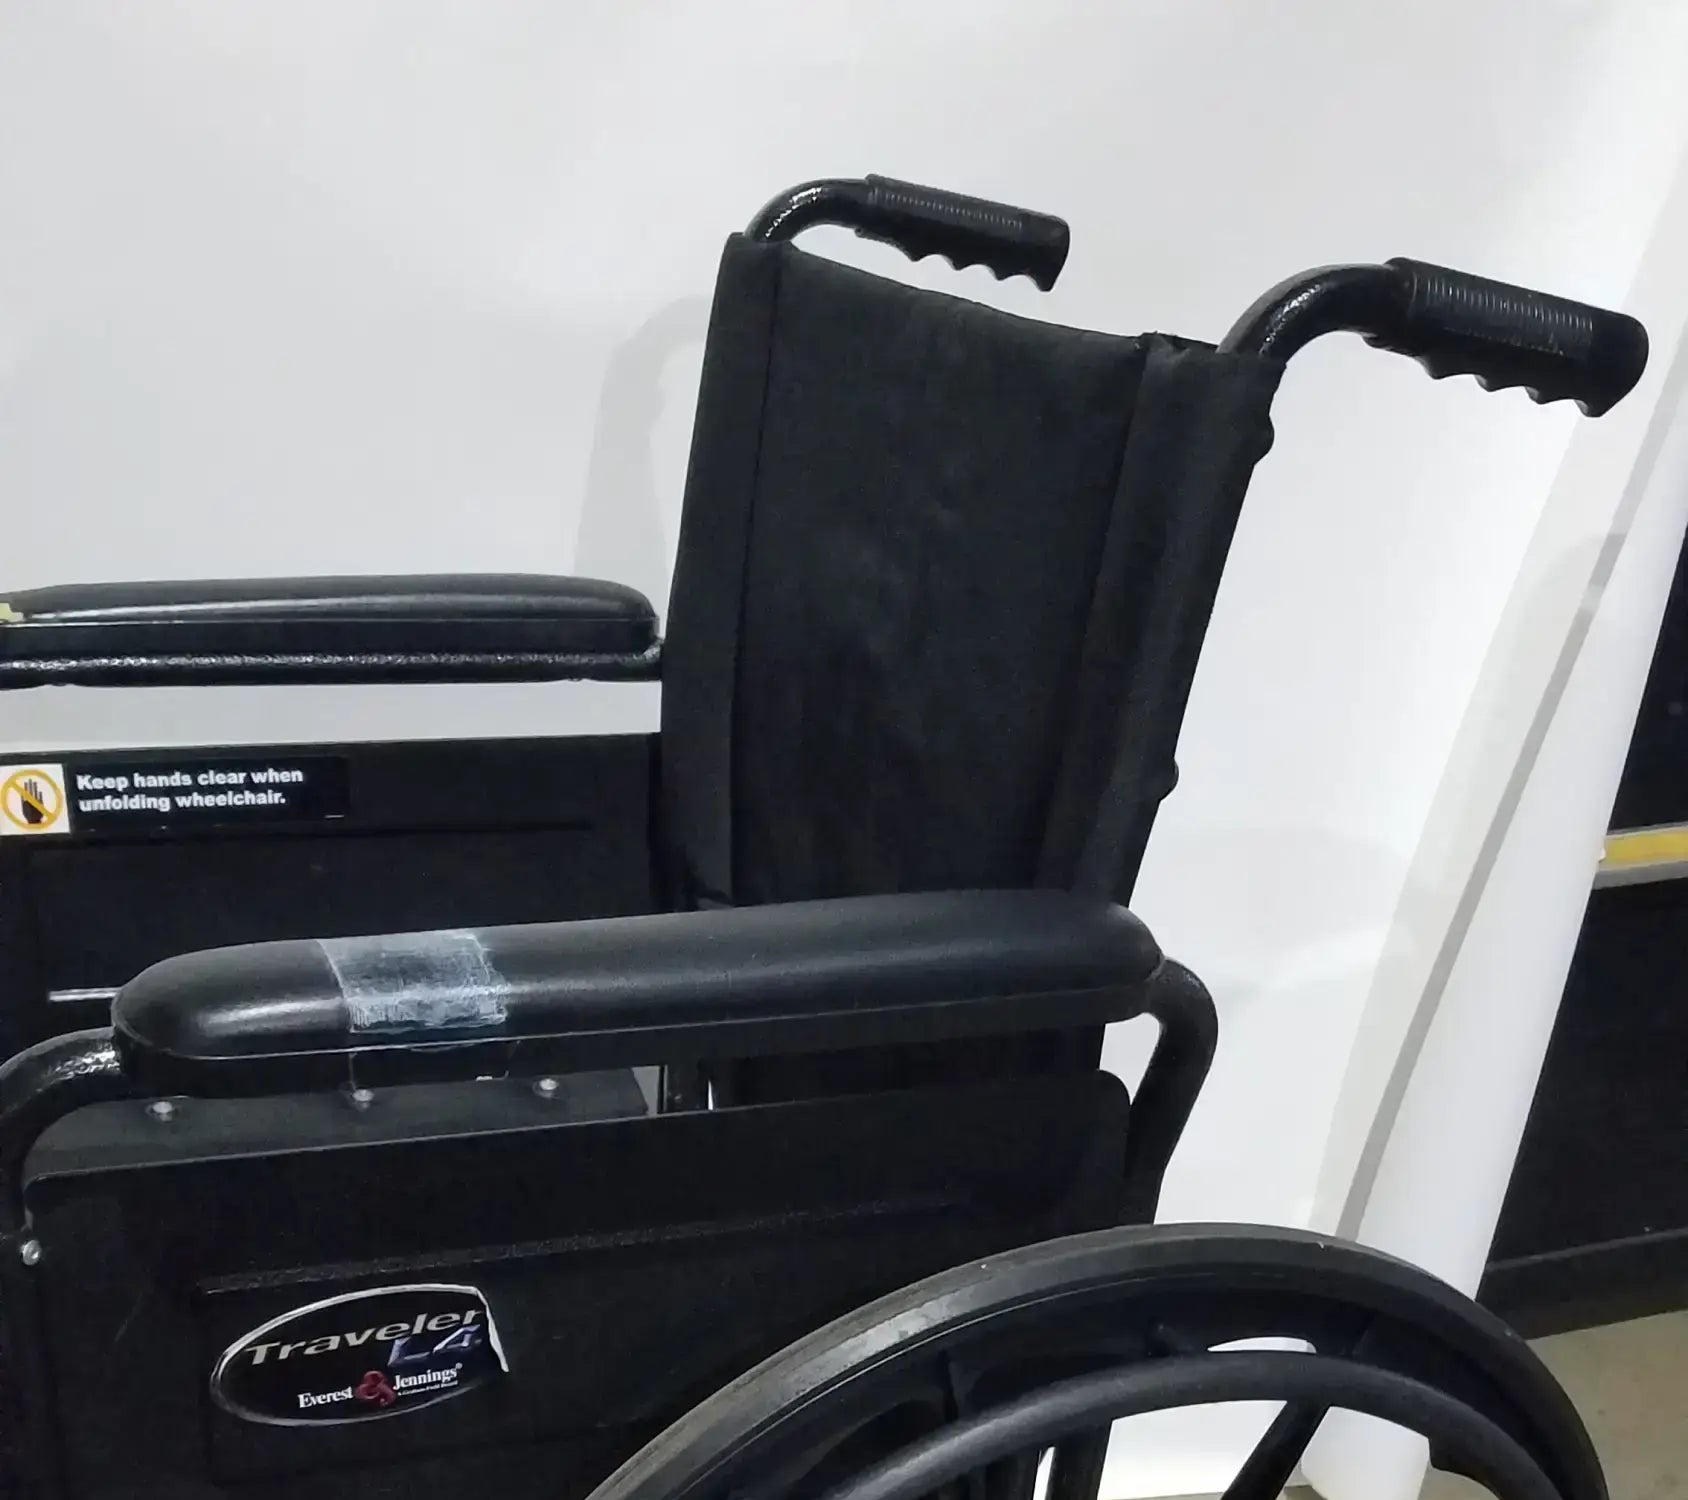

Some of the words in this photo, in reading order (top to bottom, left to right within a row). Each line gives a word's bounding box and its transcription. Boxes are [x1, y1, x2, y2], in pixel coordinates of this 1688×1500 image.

[76, 774, 129, 791] Keep
[133, 771, 192, 788] hands
[197, 769, 246, 785] clear
[251, 768, 303, 783] when
[79, 794, 170, 812] unfolding
[175, 789, 286, 808] wheelchair.
[245, 1309, 482, 1365] Traveler
[298, 1385, 354, 1408] Everest
